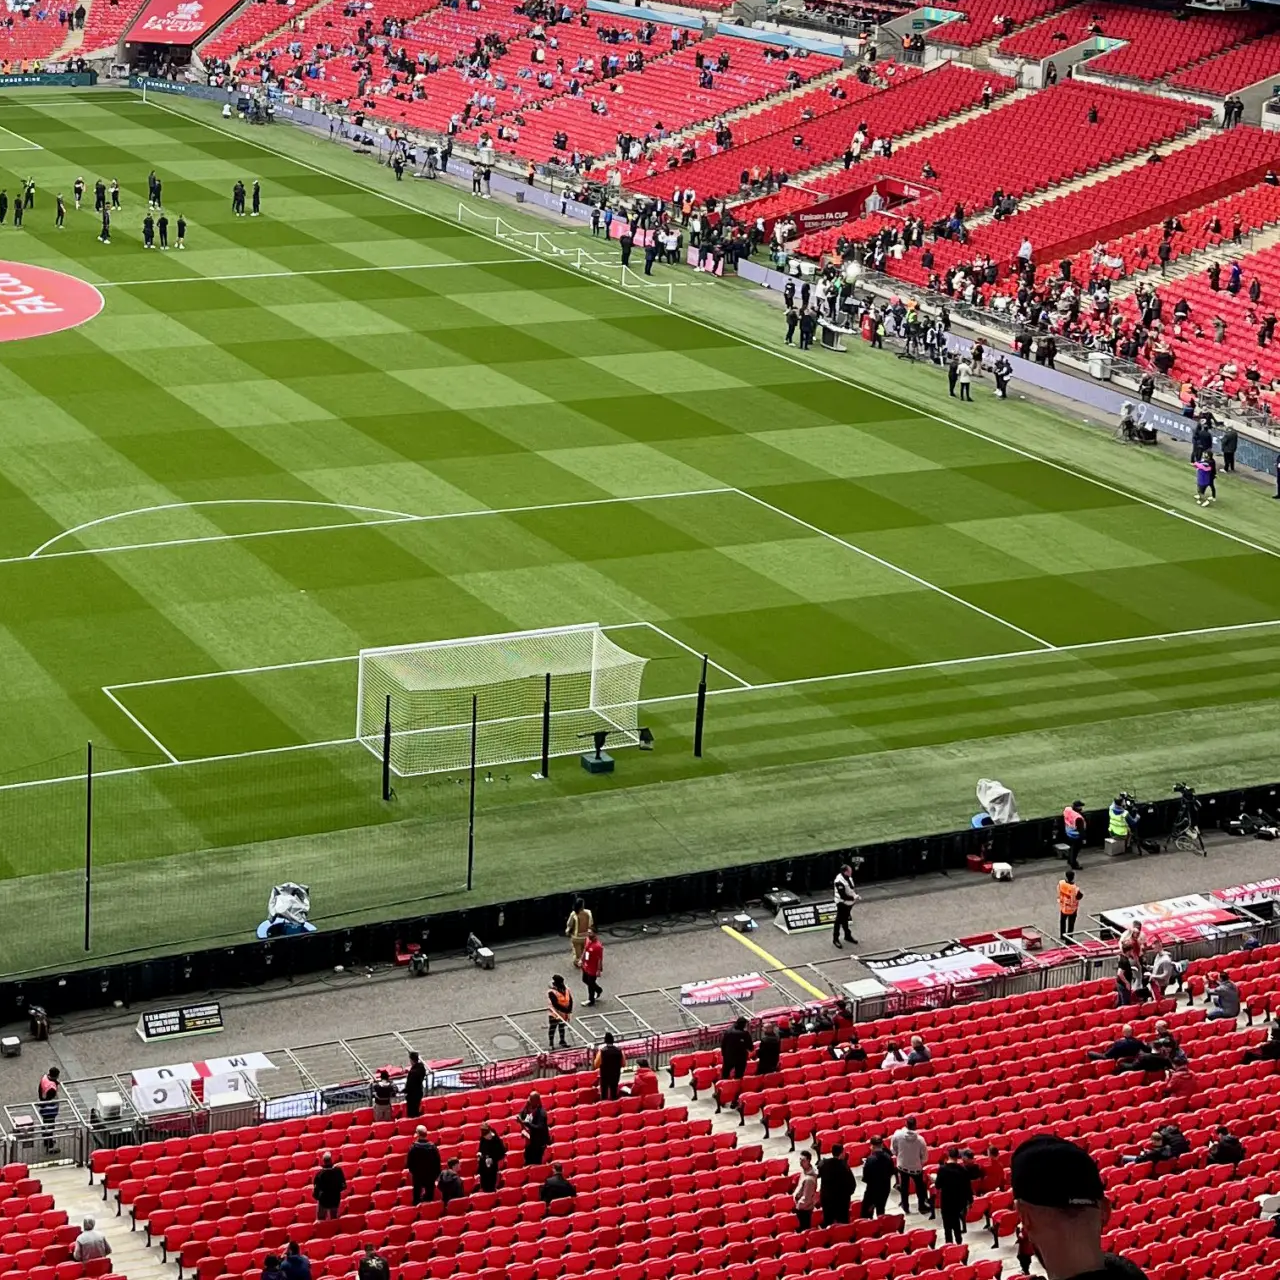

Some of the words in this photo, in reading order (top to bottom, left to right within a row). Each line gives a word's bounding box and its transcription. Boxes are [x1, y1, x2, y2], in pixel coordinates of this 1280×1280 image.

[142, 23, 163, 31] FA
[166, 24, 204, 32] CUP
[799, 213, 824, 221] Emirates
[834, 211, 849, 219] CUP
[10, 295, 64, 314] FA
[1153, 414, 1192, 433] NUMBER
